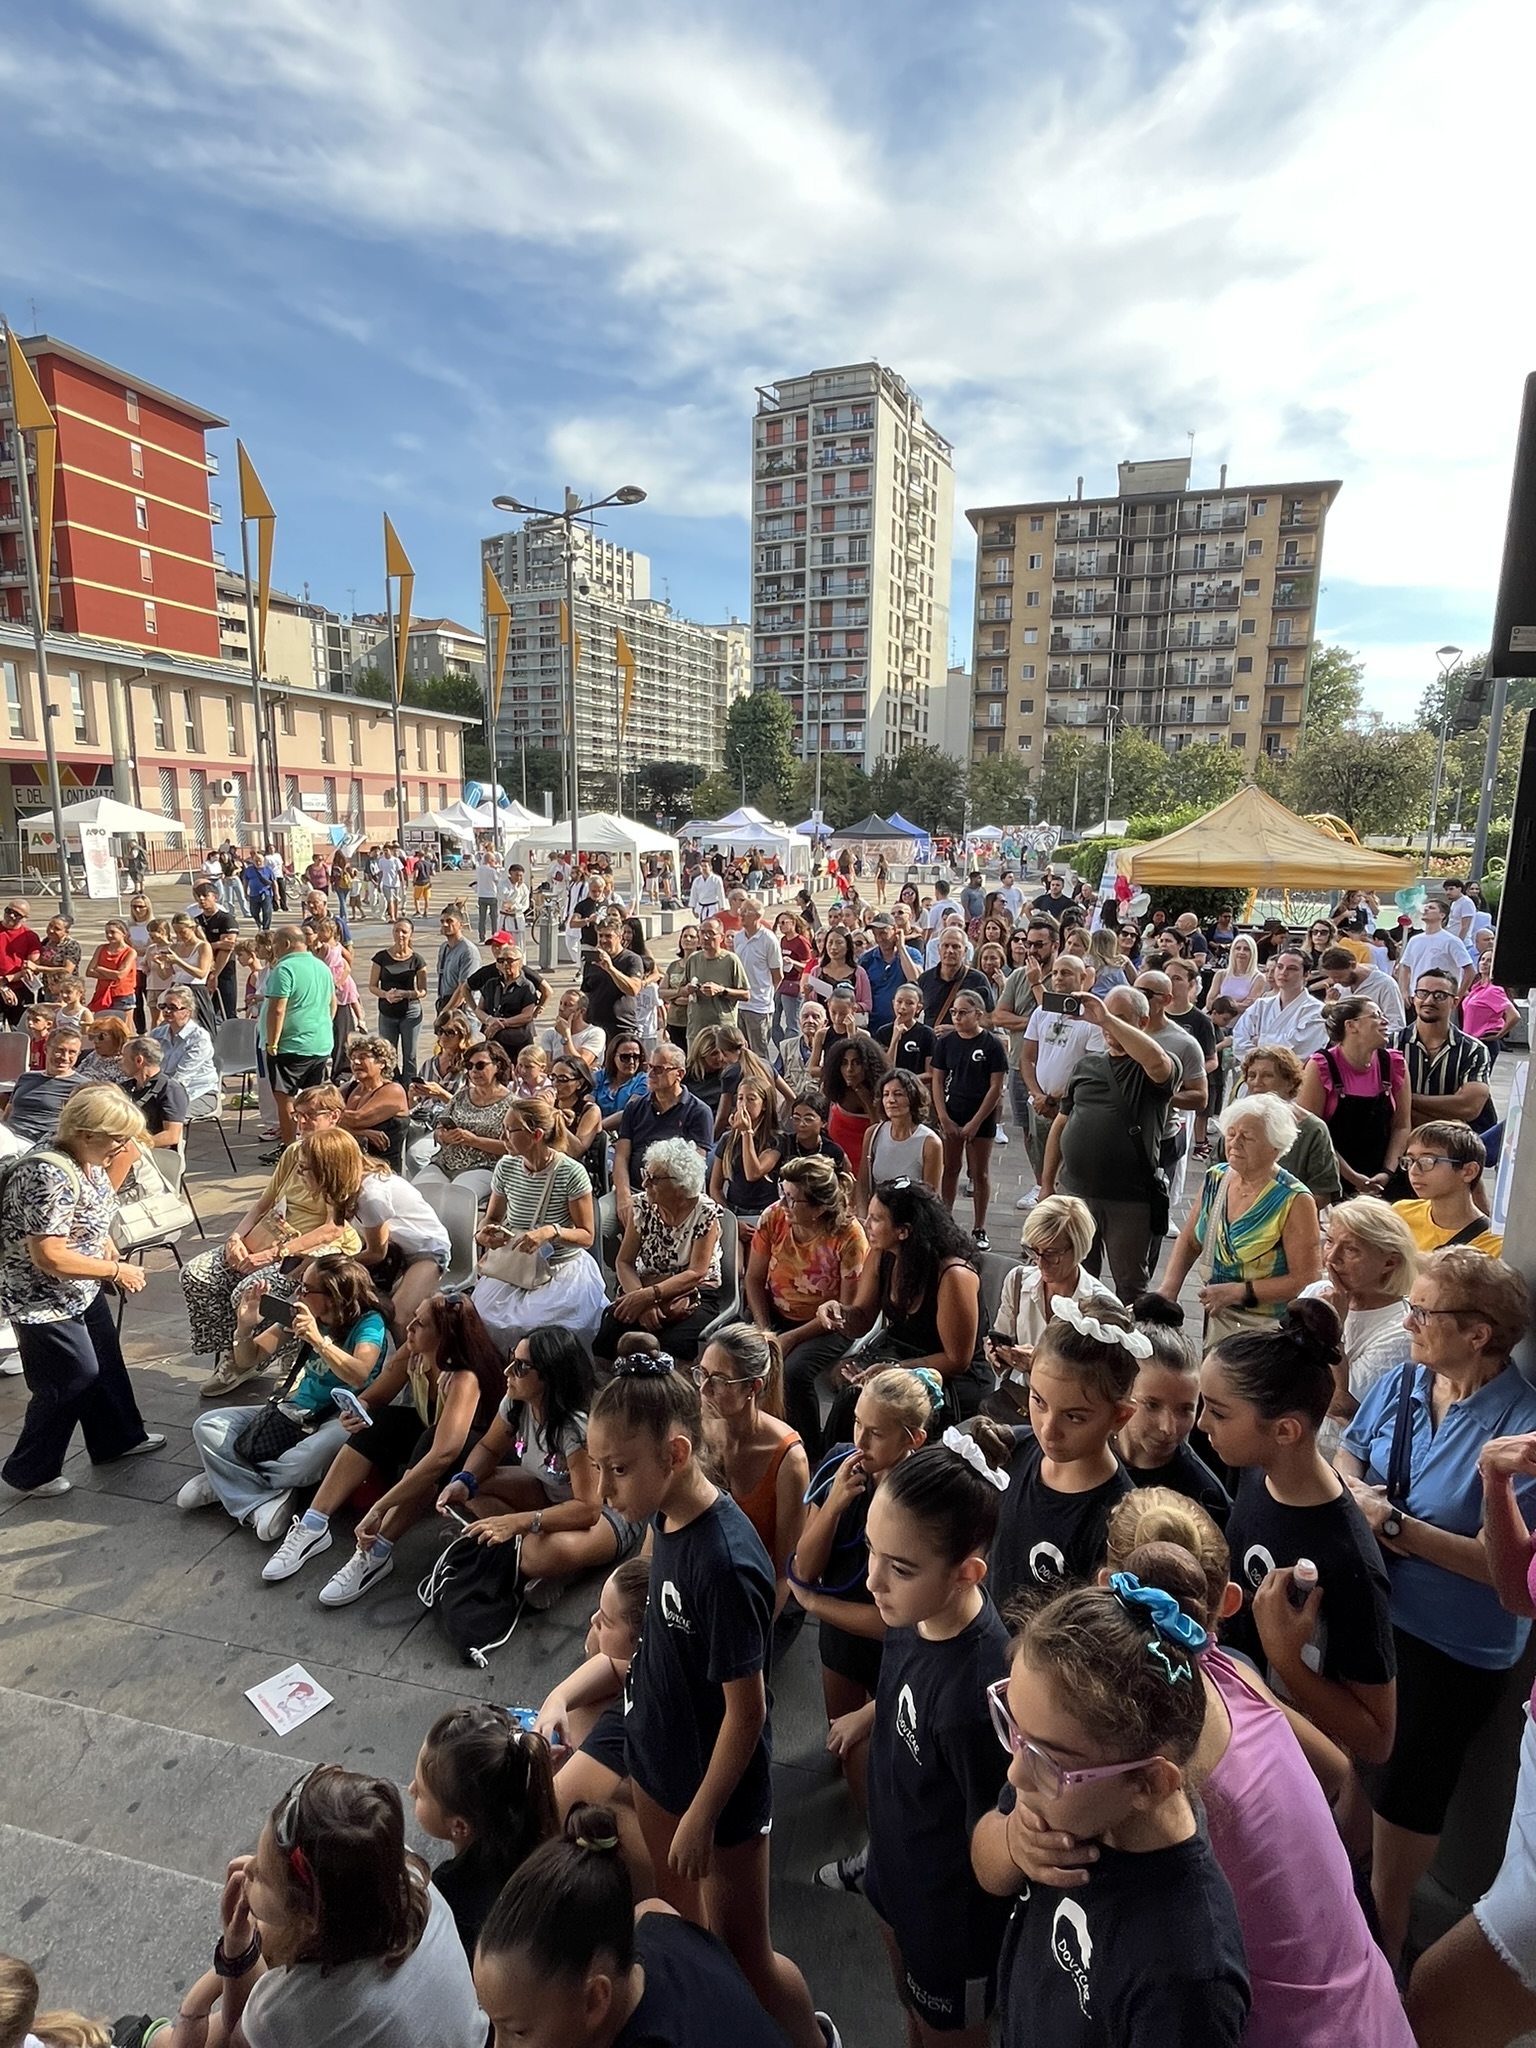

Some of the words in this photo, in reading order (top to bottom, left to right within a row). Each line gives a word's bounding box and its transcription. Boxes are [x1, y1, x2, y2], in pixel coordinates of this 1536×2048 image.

[15, 788, 22, 804] E
[27, 788, 46, 804] DEL
[61, 788, 115, 804] LONTARIATO
